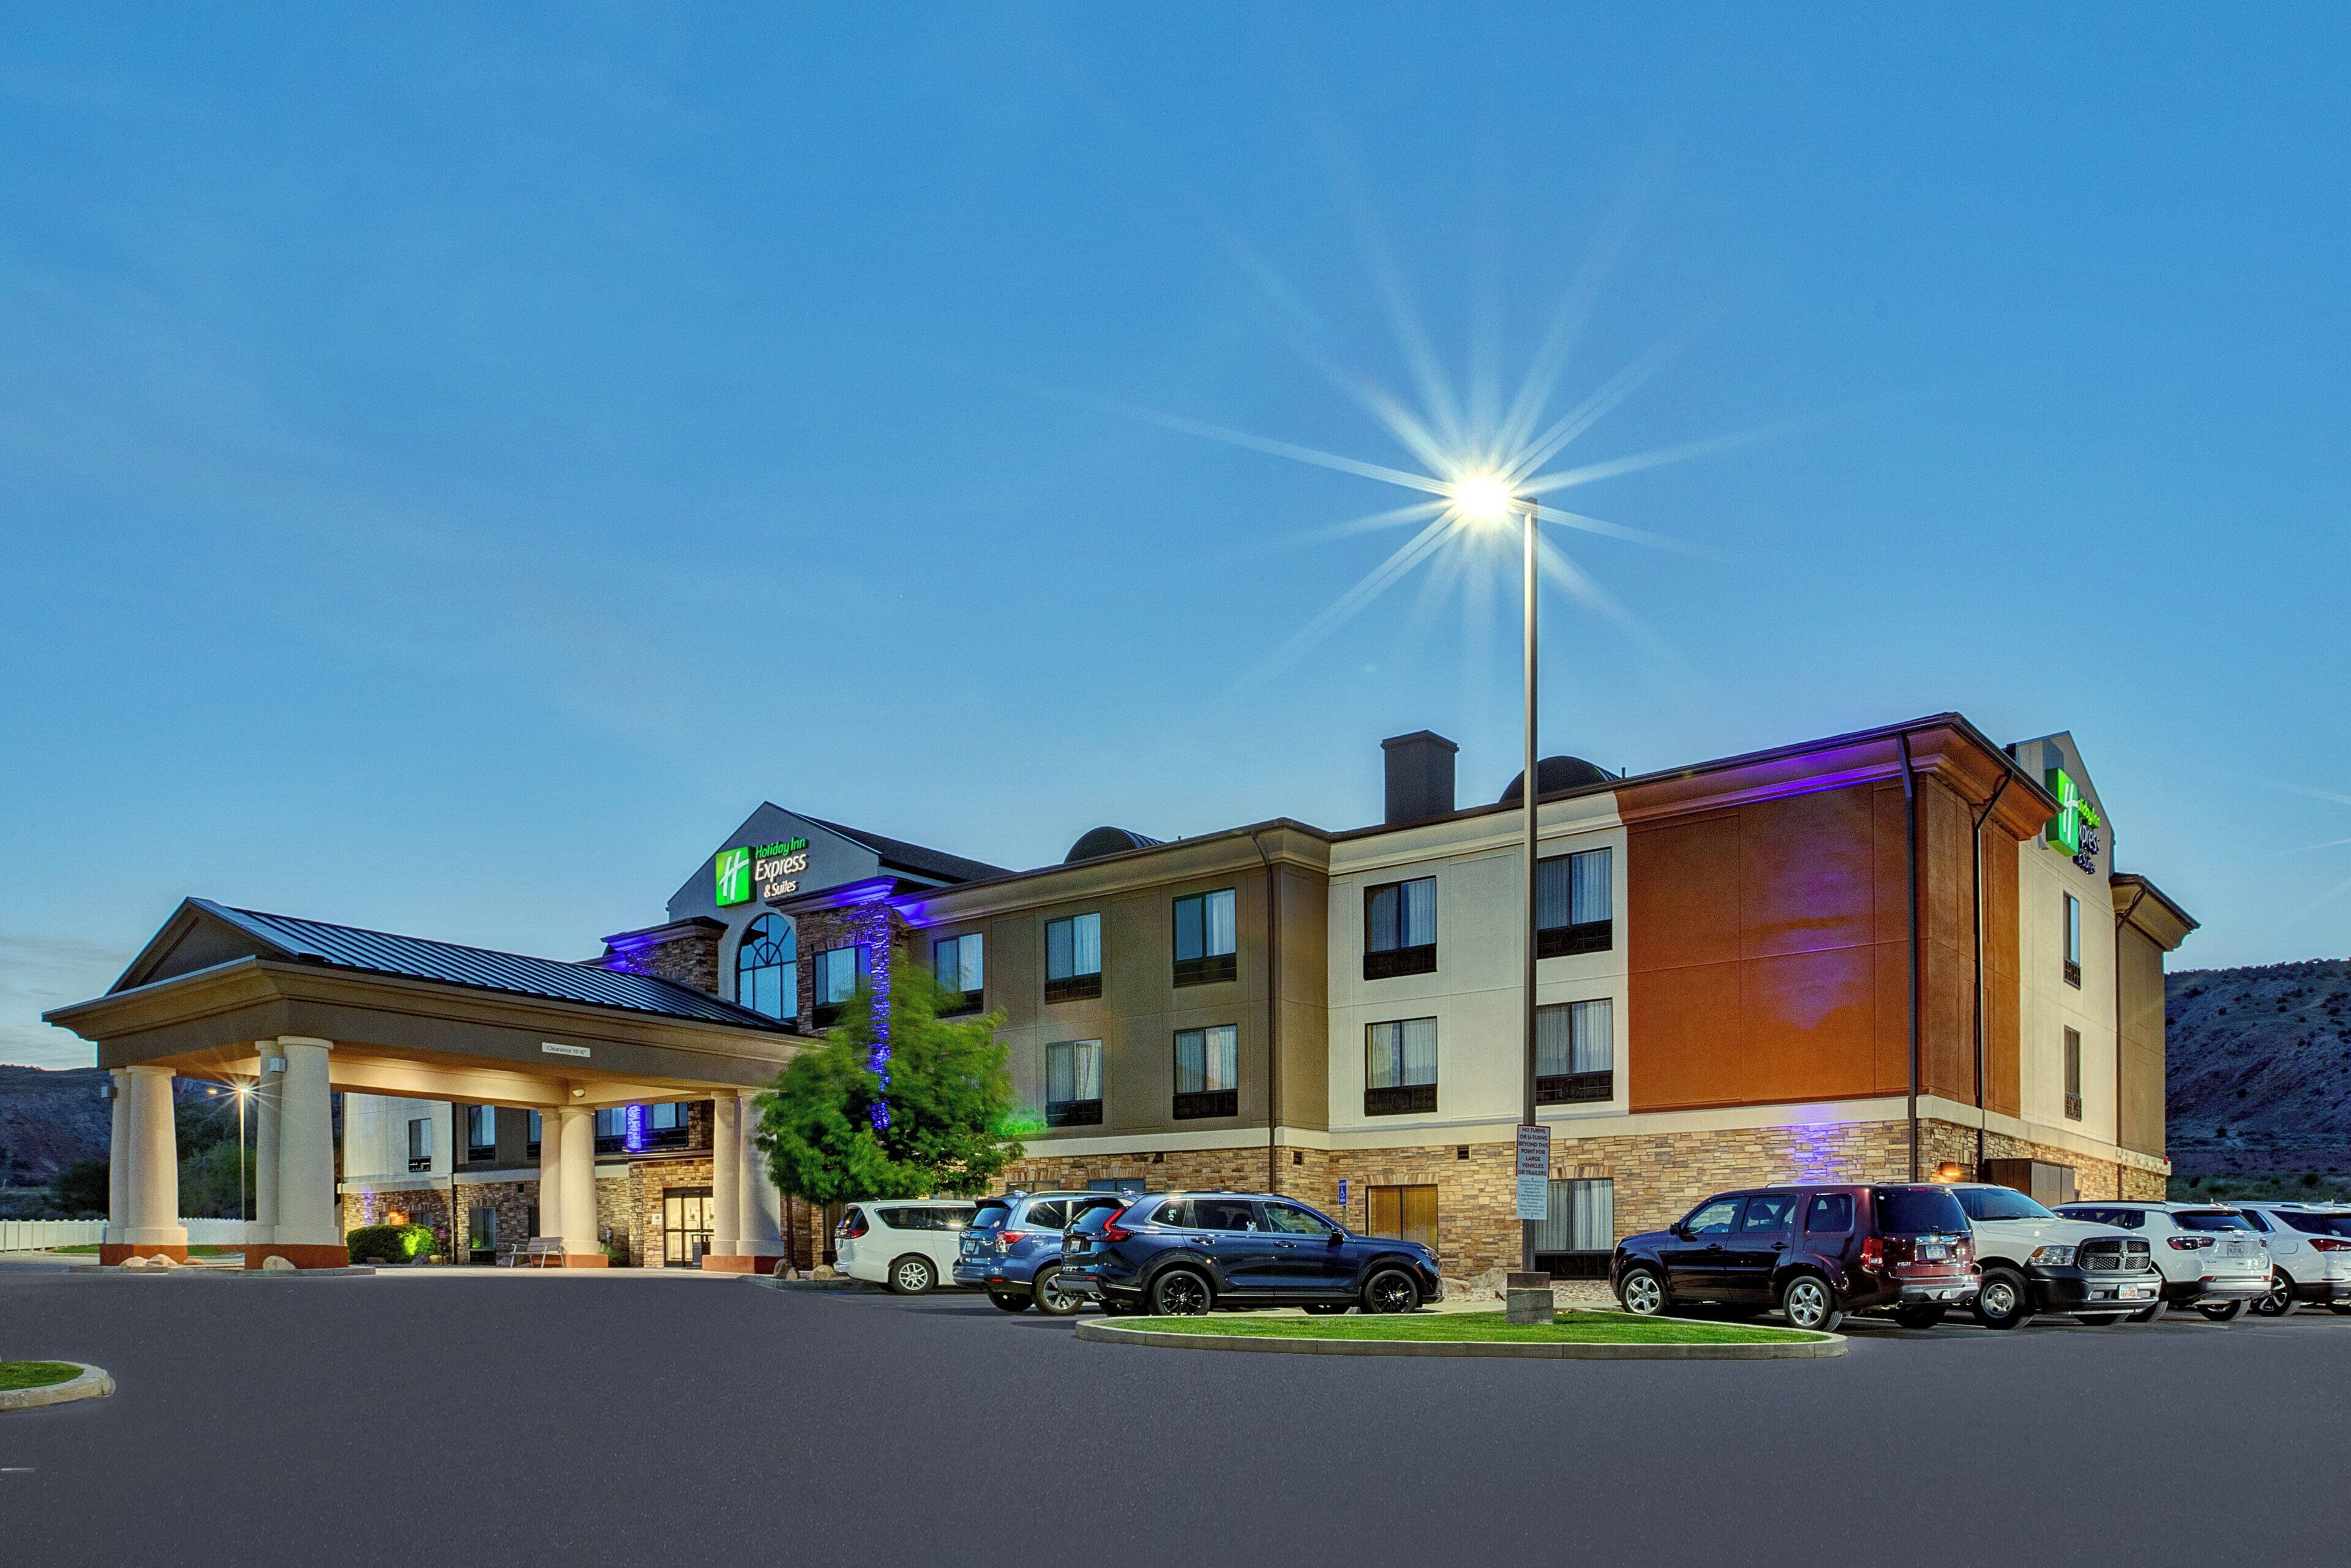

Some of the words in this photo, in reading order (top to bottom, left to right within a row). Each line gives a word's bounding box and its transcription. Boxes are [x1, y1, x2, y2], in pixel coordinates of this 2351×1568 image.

[755, 841, 790, 859] Holiday
[790, 836, 806, 850] Inn
[754, 853, 806, 882] Express
[763, 884, 771, 898] &
[771, 880, 797, 896] Suites
[547, 1045, 572, 1054] Clearance
